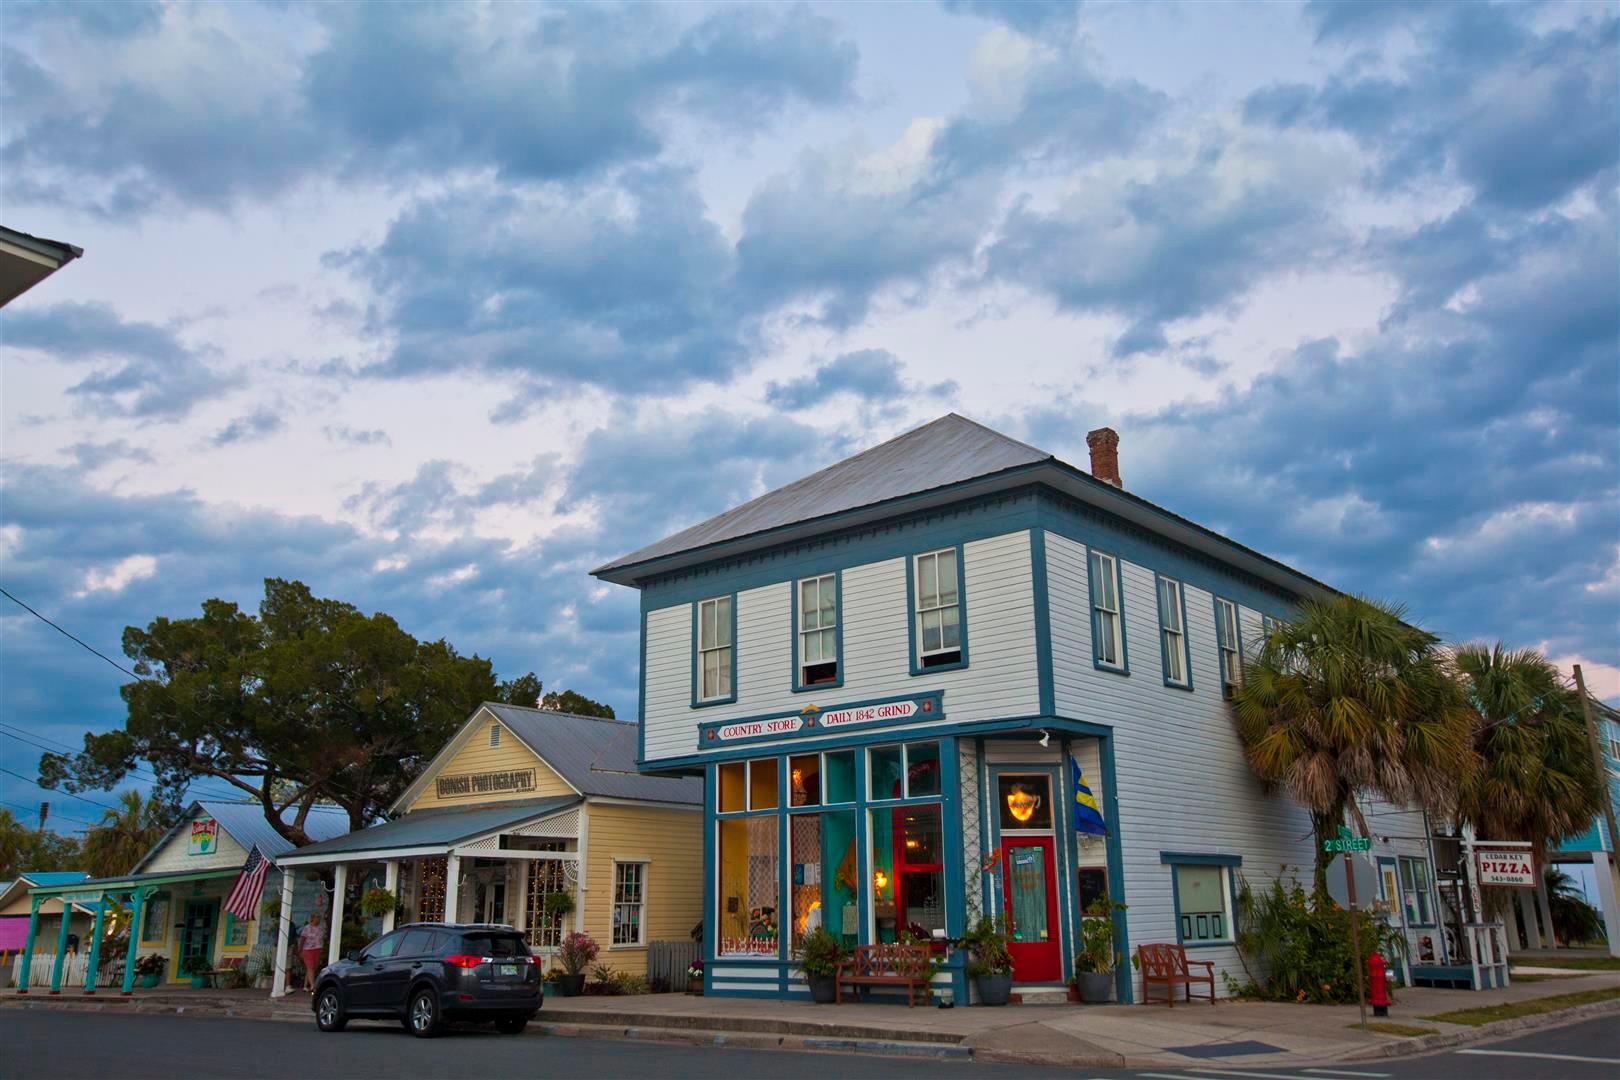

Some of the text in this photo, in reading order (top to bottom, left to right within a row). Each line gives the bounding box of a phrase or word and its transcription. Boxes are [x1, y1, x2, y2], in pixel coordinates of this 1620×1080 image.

[826, 703, 911, 725] DAILY 1842 GRIND
[723, 719, 797, 738] COUNTRY STORE
[471, 770, 532, 793] PHOTOGRAPHY
[1335, 838, 1369, 851] STREET
[1481, 862, 1531, 874] PIZZA
